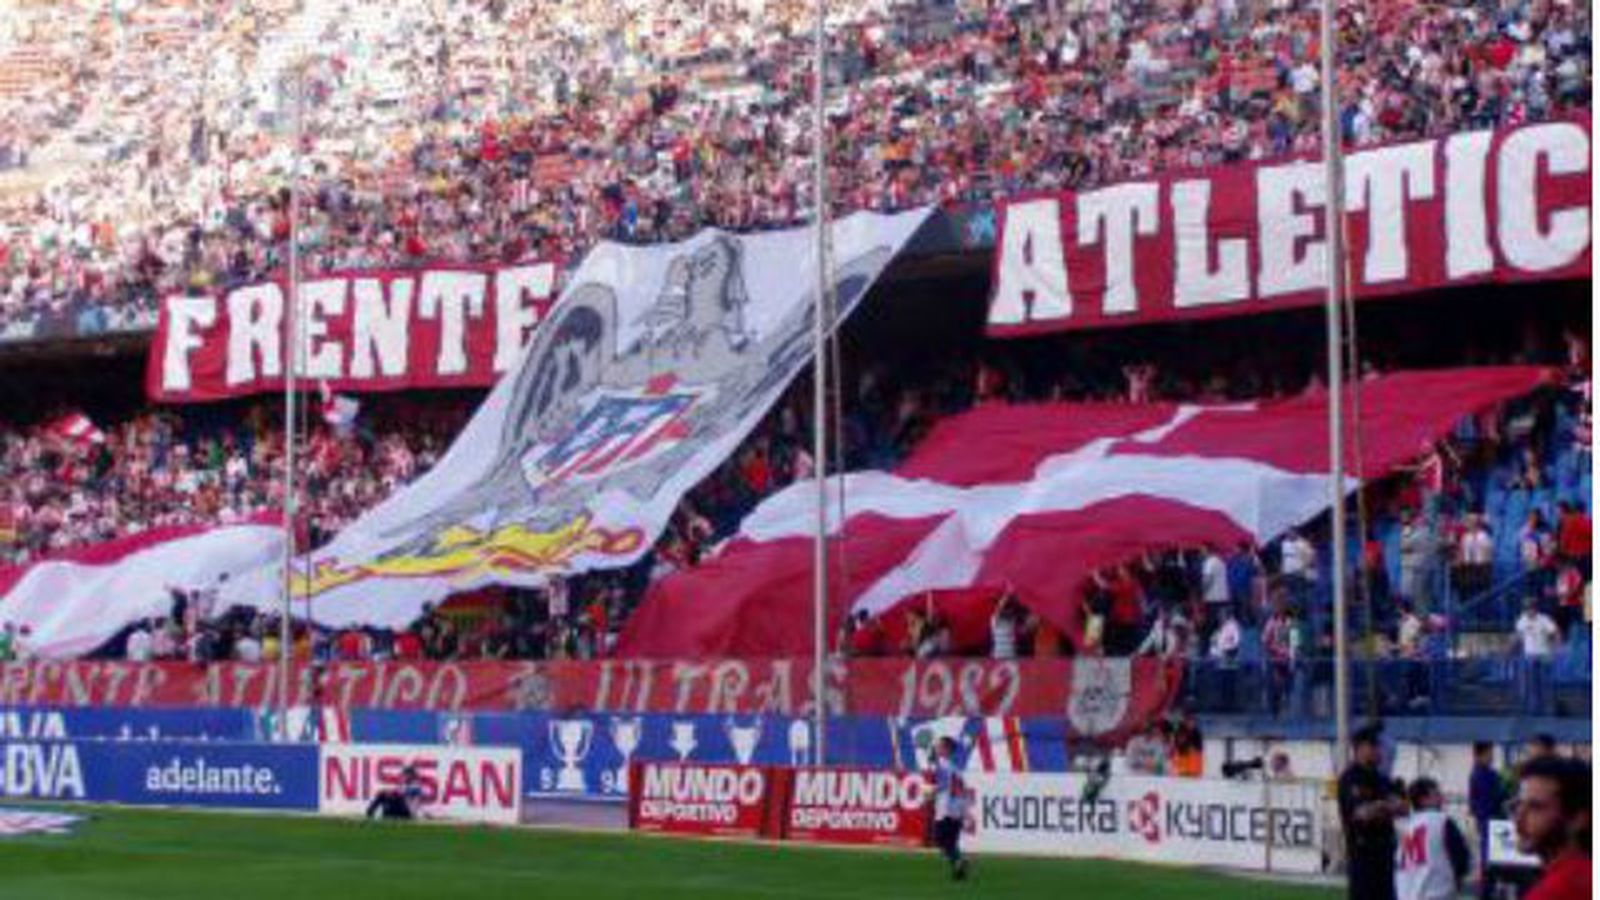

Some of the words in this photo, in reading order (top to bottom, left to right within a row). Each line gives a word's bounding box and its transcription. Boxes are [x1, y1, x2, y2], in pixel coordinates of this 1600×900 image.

[161, 263, 556, 391] FRENTE
[0, 743, 86, 798] BVA
[325, 756, 515, 808] NISSAN
[642, 765, 764, 804] MUNDO
[795, 770, 926, 809] MUNDO
[639, 801, 737, 822] DEPORTIVO
[792, 807, 898, 830] DEPORTIVO
